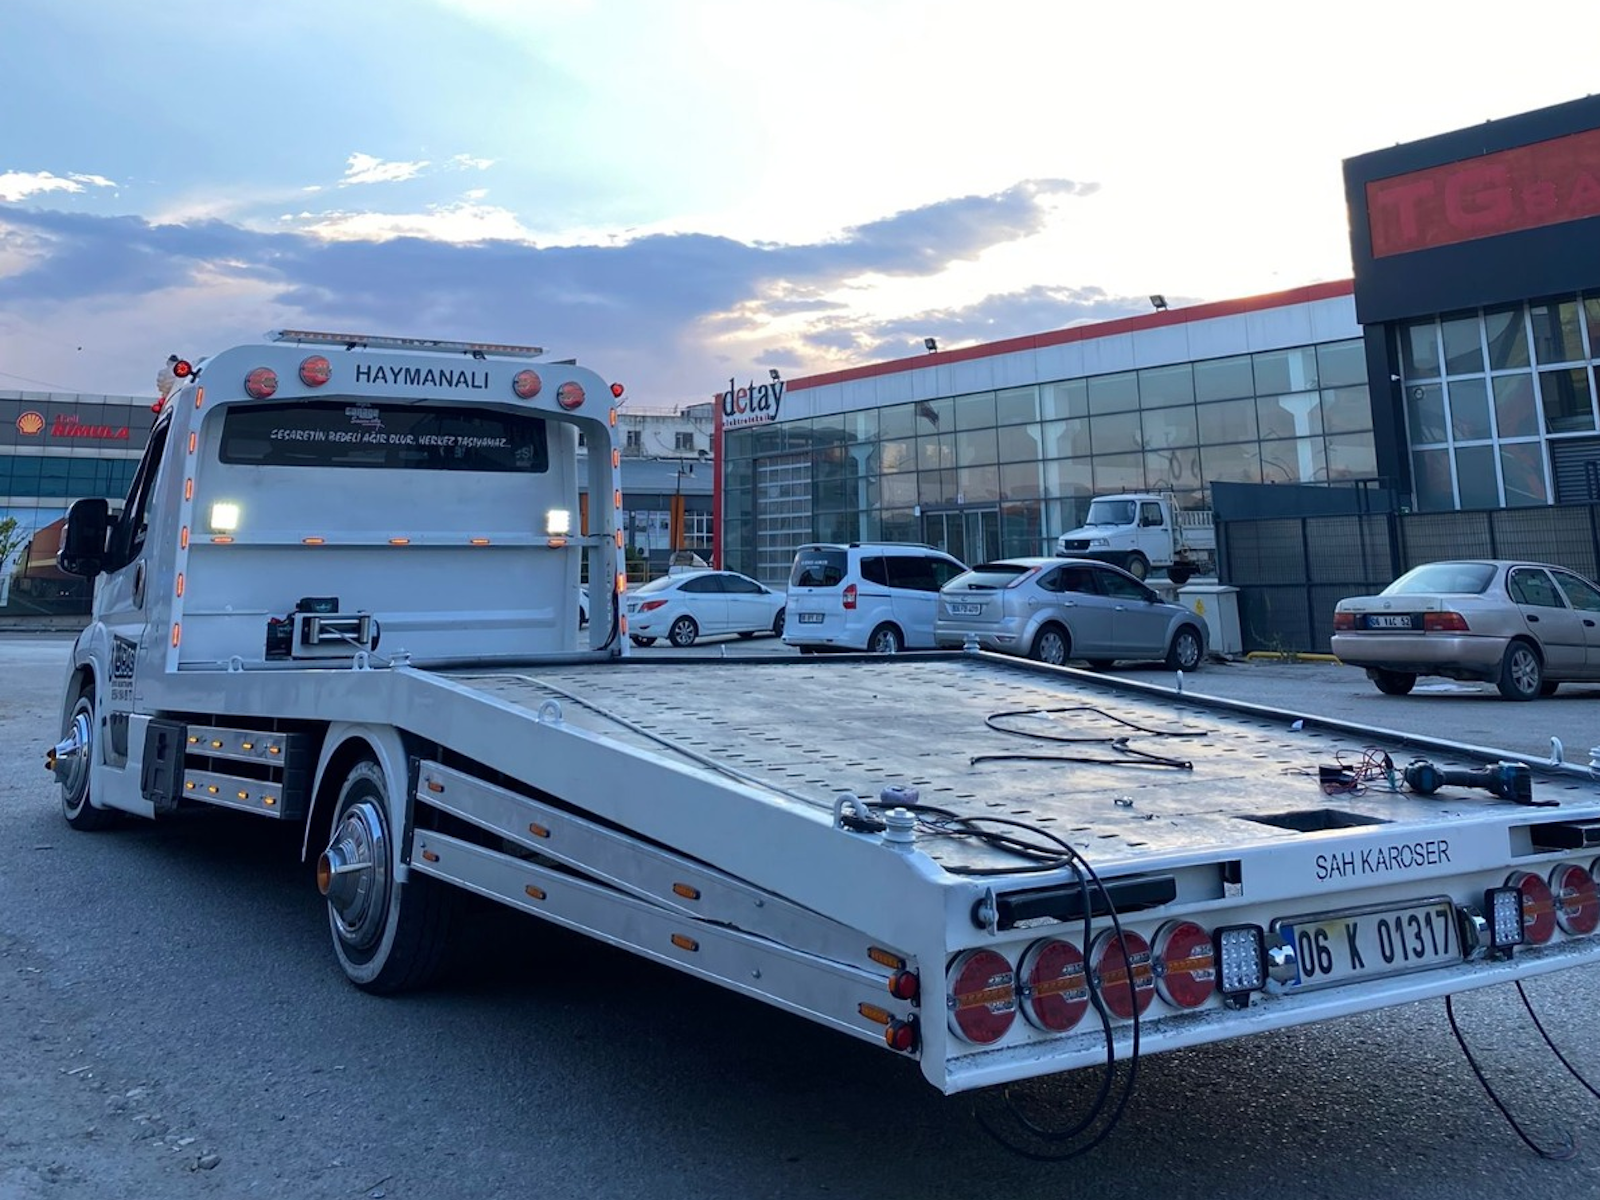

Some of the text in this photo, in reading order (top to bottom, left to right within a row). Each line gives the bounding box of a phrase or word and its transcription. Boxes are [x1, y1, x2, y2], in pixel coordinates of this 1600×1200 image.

[356, 364, 489, 389] HAYMANALI
[723, 377, 784, 421] detay
[51, 424, 130, 440] RIMULA
[1360, 840, 1452, 874] KAROSER
[1298, 909, 1450, 978] 06 K 01317
